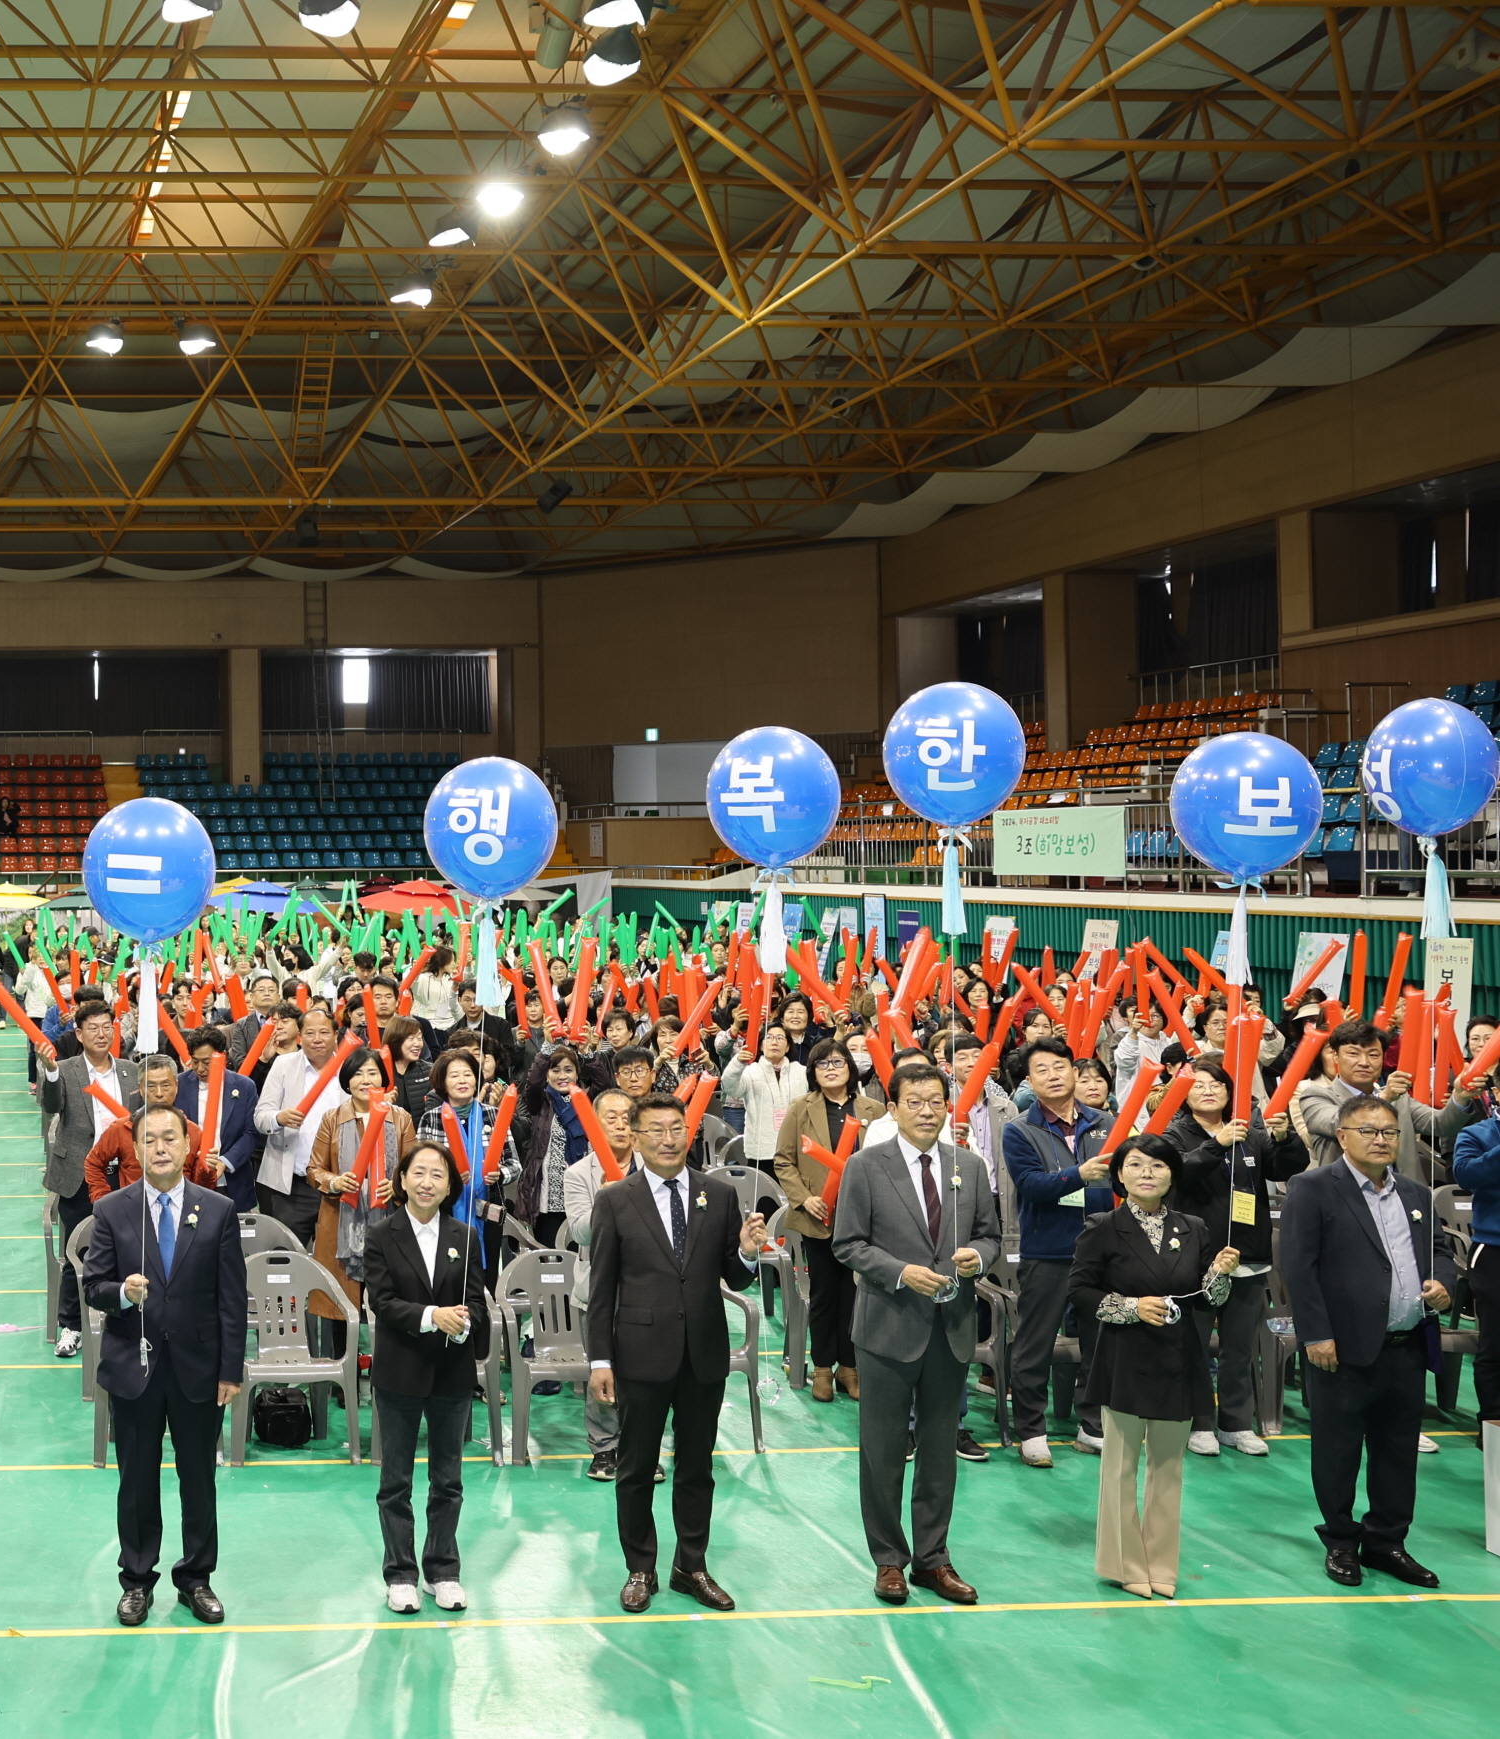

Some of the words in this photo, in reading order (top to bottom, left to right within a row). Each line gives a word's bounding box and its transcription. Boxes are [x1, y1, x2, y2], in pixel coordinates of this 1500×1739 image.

[915, 718, 986, 791] 한
[1362, 747, 1402, 821] 성
[447, 787, 511, 866] 행
[720, 755, 785, 833] 복
[1224, 776, 1298, 836] 보
